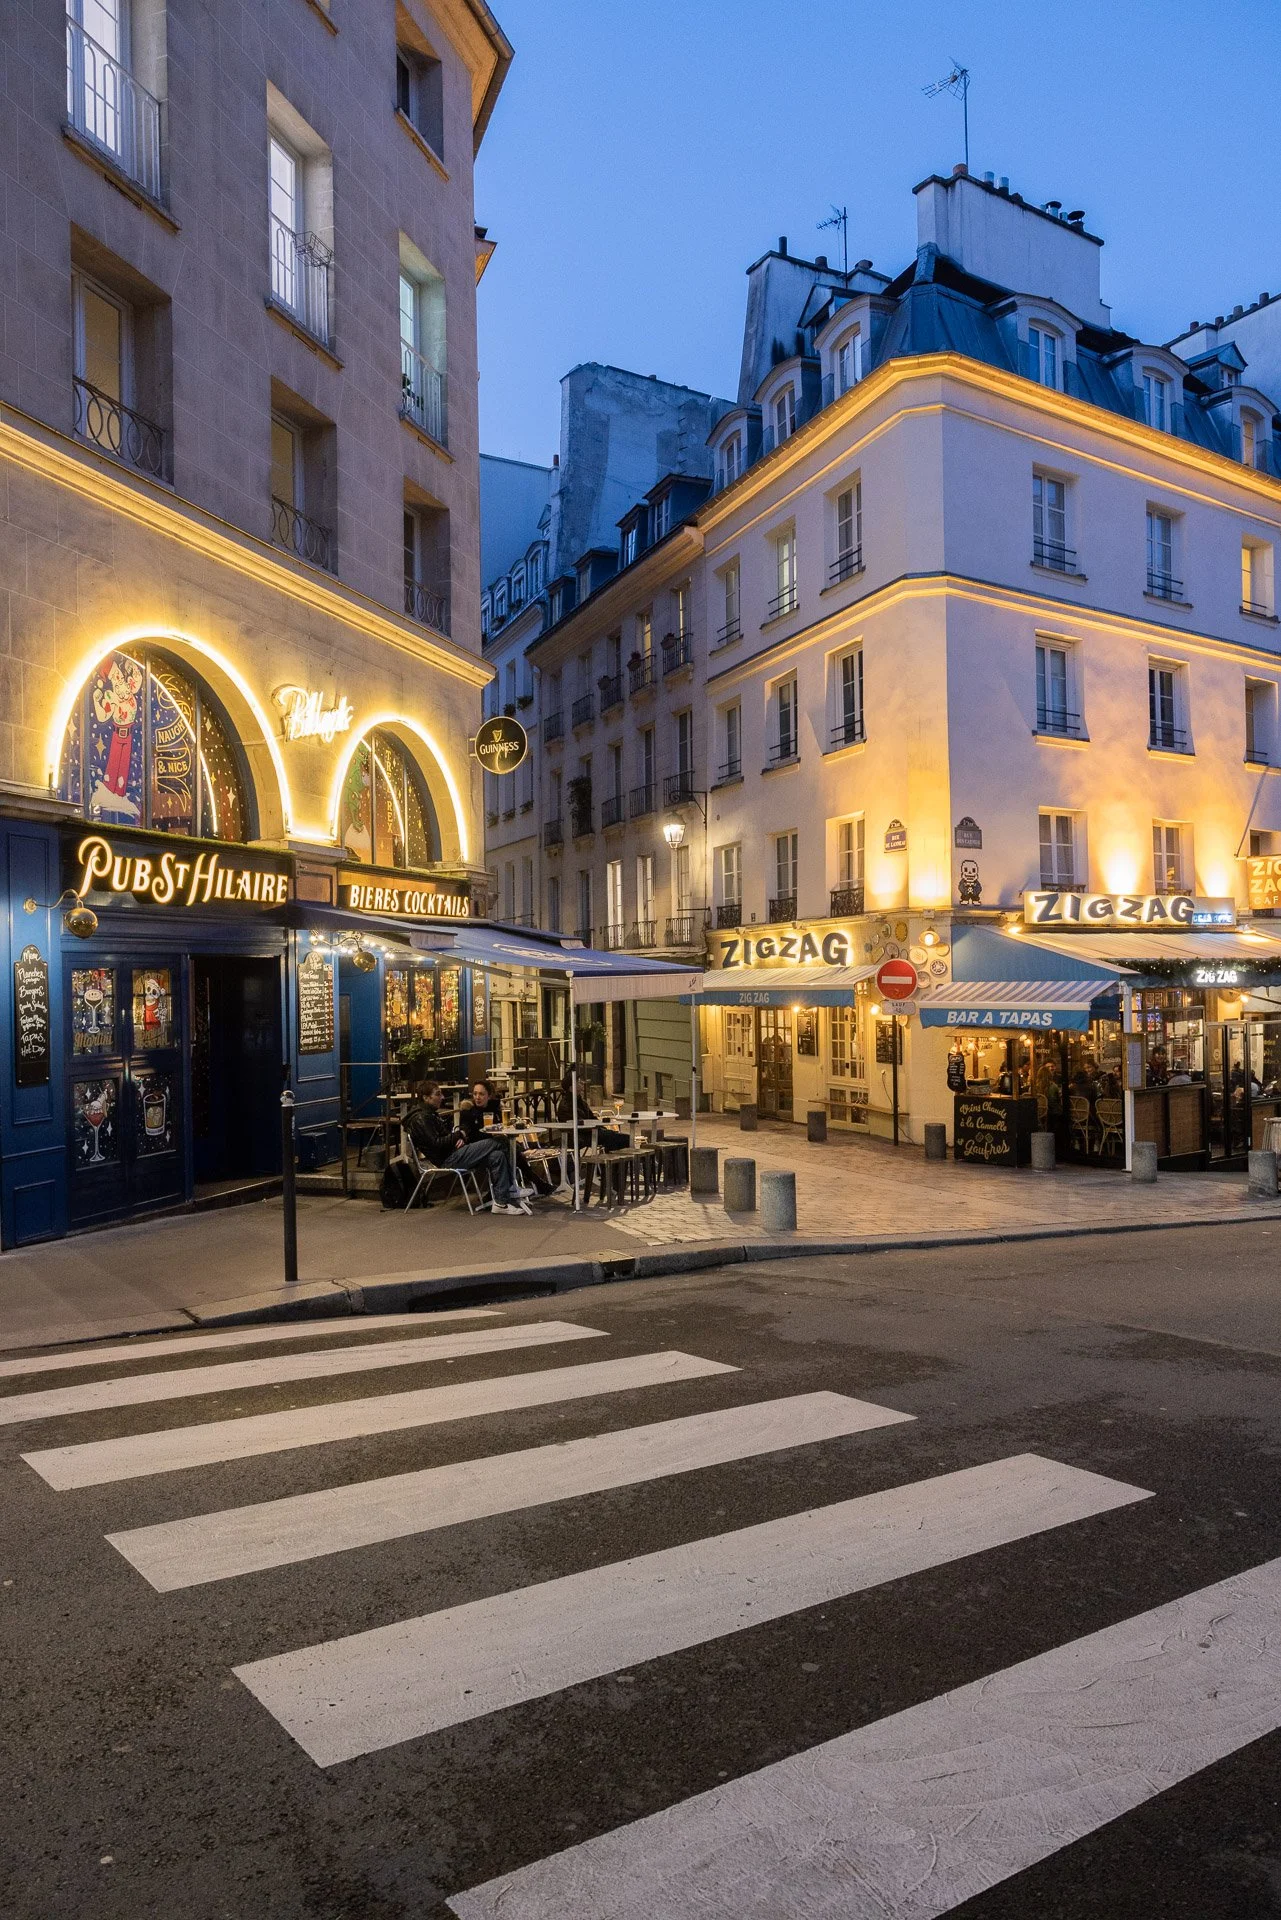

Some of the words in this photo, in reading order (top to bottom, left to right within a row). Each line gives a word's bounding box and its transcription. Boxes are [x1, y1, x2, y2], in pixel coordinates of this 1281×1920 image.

[479, 741, 520, 756] GUINNESS
[157, 761, 167, 774] &
[168, 761, 188, 773] NICE
[78, 836, 152, 898] PUB
[186, 853, 288, 906] HILAIRE
[1250, 877, 1281, 894] ZA
[350, 884, 399, 912] BIERES
[404, 890, 469, 917] COCKTAILS
[1034, 893, 1195, 924] ZIGZAG
[720, 932, 849, 968] ZIGZAG
[1196, 970, 1216, 983] ZIG
[1216, 970, 1238, 983] ZAG
[739, 992, 752, 1003] ZIG
[753, 992, 769, 1003] ZAG
[947, 1011, 979, 1023] BAR
[981, 1011, 993, 1024] A
[1000, 1012, 1053, 1026] TAPAS
[964, 1139, 1010, 1160] Gaufres
